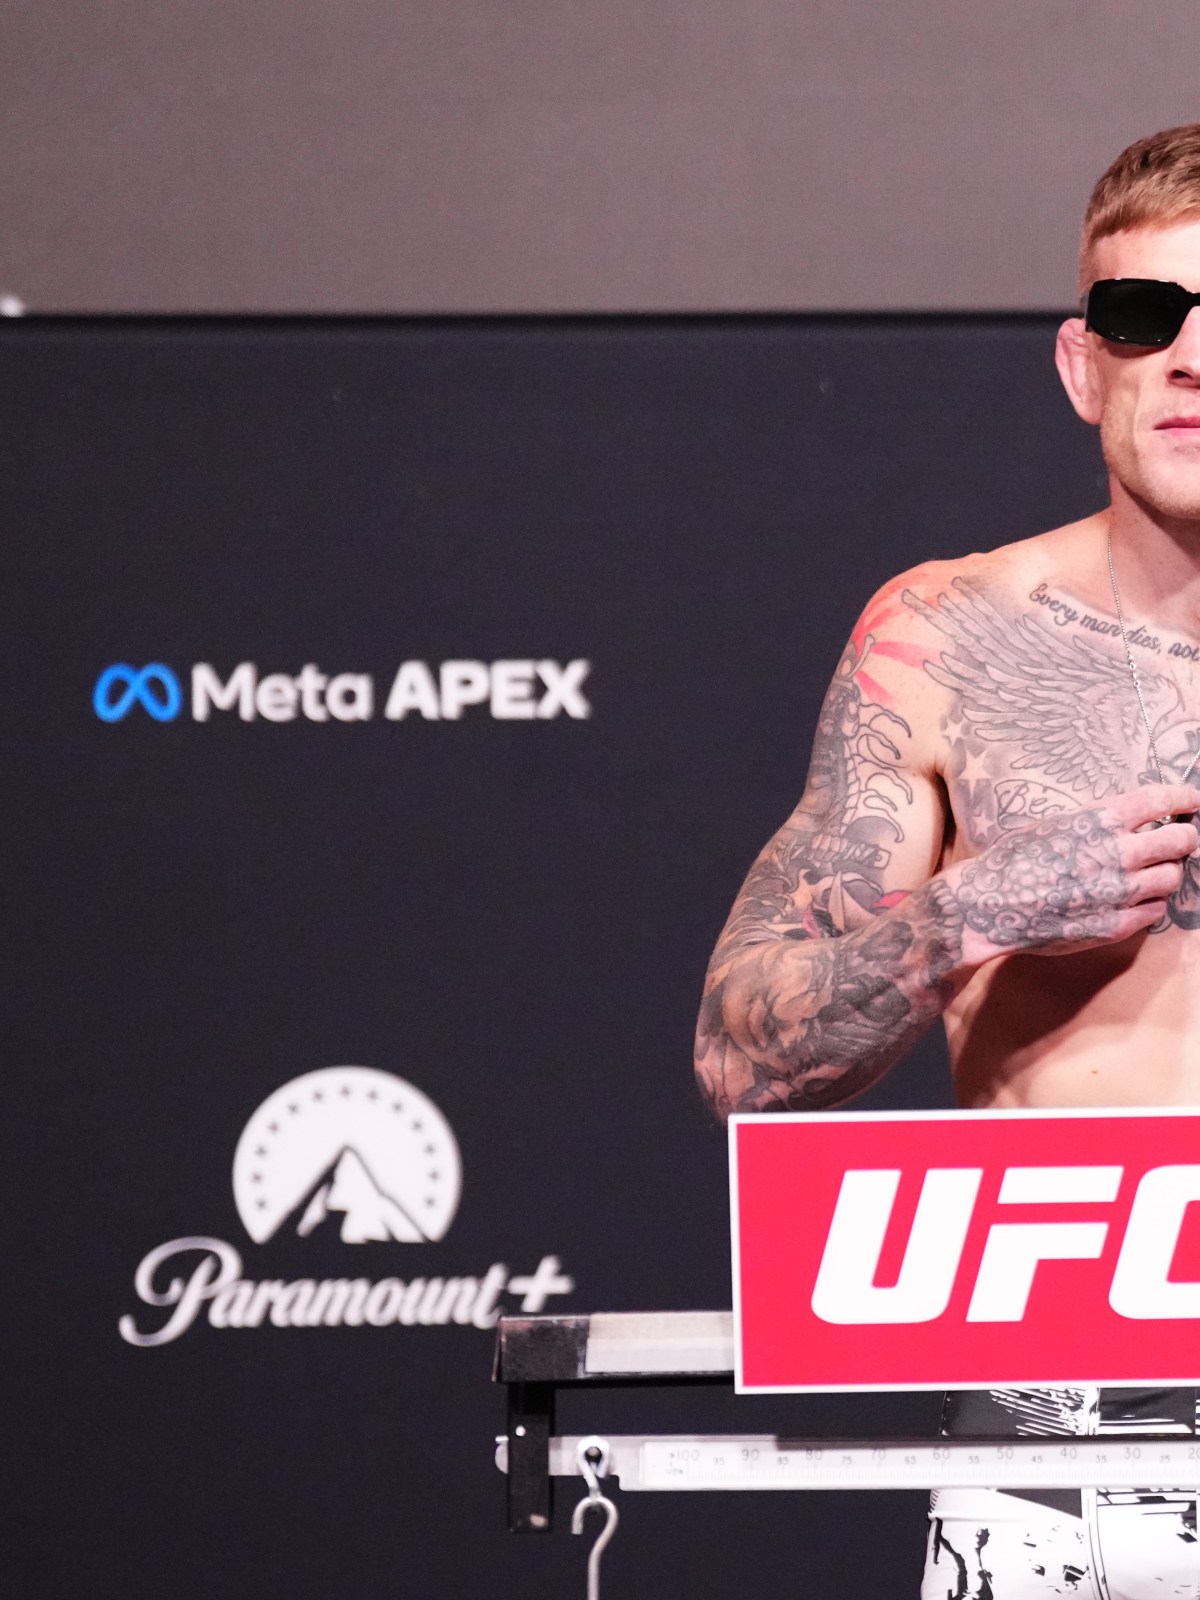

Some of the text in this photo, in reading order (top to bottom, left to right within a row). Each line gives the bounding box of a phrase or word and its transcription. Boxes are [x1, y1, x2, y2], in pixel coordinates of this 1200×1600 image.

[1029, 583, 1078, 626] Every
[1080, 613, 1121, 637] man
[1126, 625, 1162, 654] dies,
[1168, 642, 1200, 661] not
[191, 659, 591, 722] Meta APEX
[741, 1448, 760, 1461] 90
[805, 1449, 823, 1461] 80
[933, 1448, 951, 1461] 60
[996, 1447, 1014, 1460] 50
[1031, 1455, 1043, 1464] 45
[1060, 1447, 1078, 1460] 40
[1124, 1447, 1141, 1460] 30
[1160, 1455, 1171, 1464] 25
